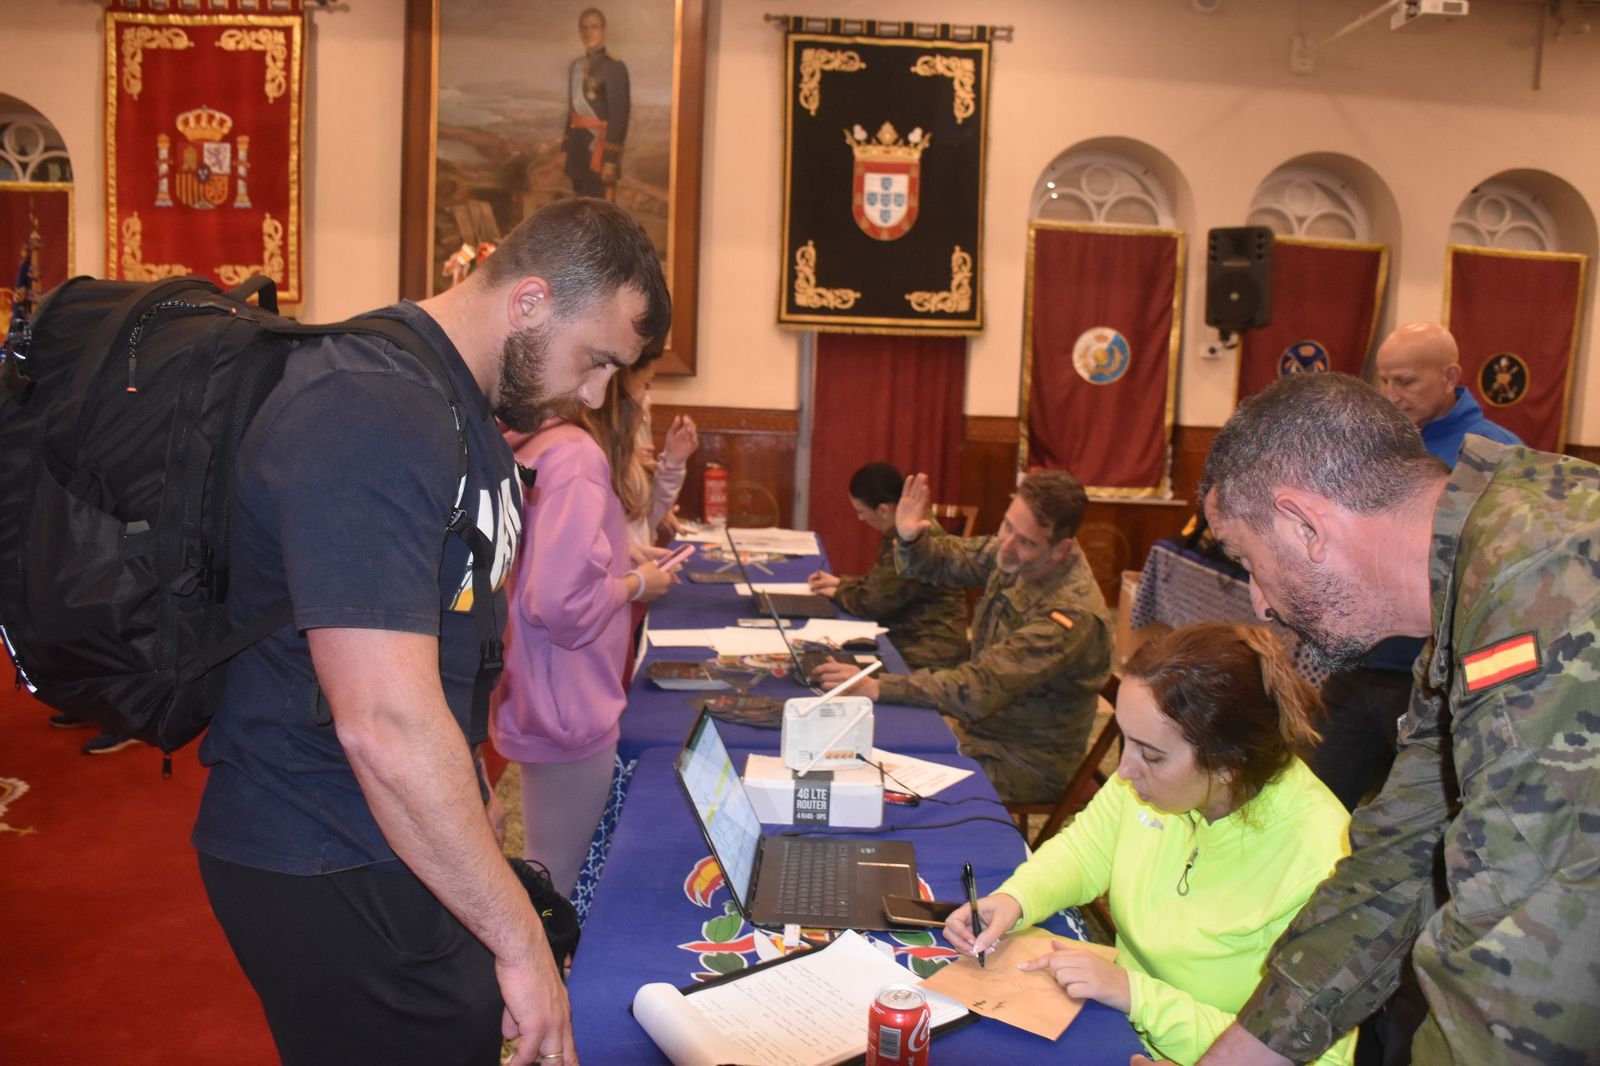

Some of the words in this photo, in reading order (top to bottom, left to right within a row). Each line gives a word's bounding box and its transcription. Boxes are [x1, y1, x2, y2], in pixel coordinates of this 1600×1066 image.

[797, 788, 809, 799] 4G
[811, 788, 828, 800] LTE
[796, 799, 827, 810] ROUTER
